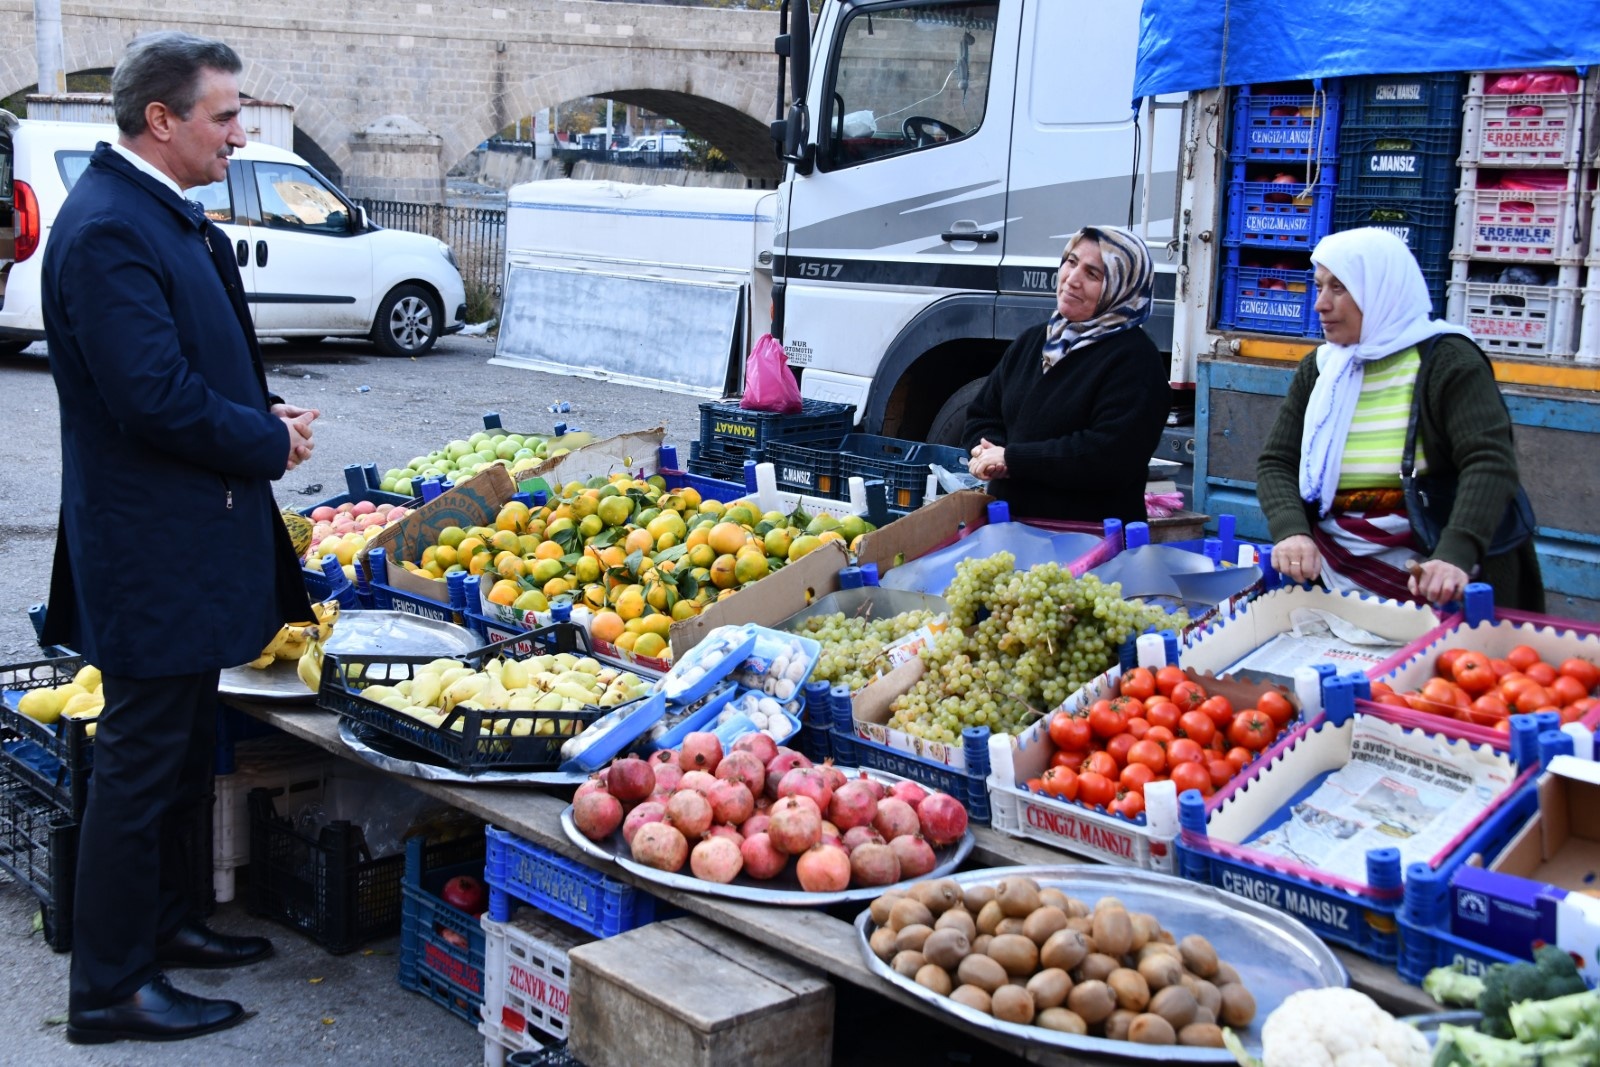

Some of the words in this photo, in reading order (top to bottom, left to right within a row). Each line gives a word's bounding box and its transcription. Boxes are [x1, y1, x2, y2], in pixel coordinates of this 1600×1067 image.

[1371, 156, 1415, 172] C.MANSIZ
[1479, 227, 1551, 237] ERDEMLER
[798, 262, 844, 278] 1517
[1021, 270, 1048, 289] NUR
[792, 340, 807, 348] NUR
[714, 422, 756, 438] KANAAT
[782, 467, 811, 485] C.MANSIZ
[866, 751, 950, 790] ERDEMLER
[1078, 821, 1134, 859] MANSIZ
[1284, 888, 1349, 930] MANSIZ
[509, 965, 546, 1004] MANSIZ
